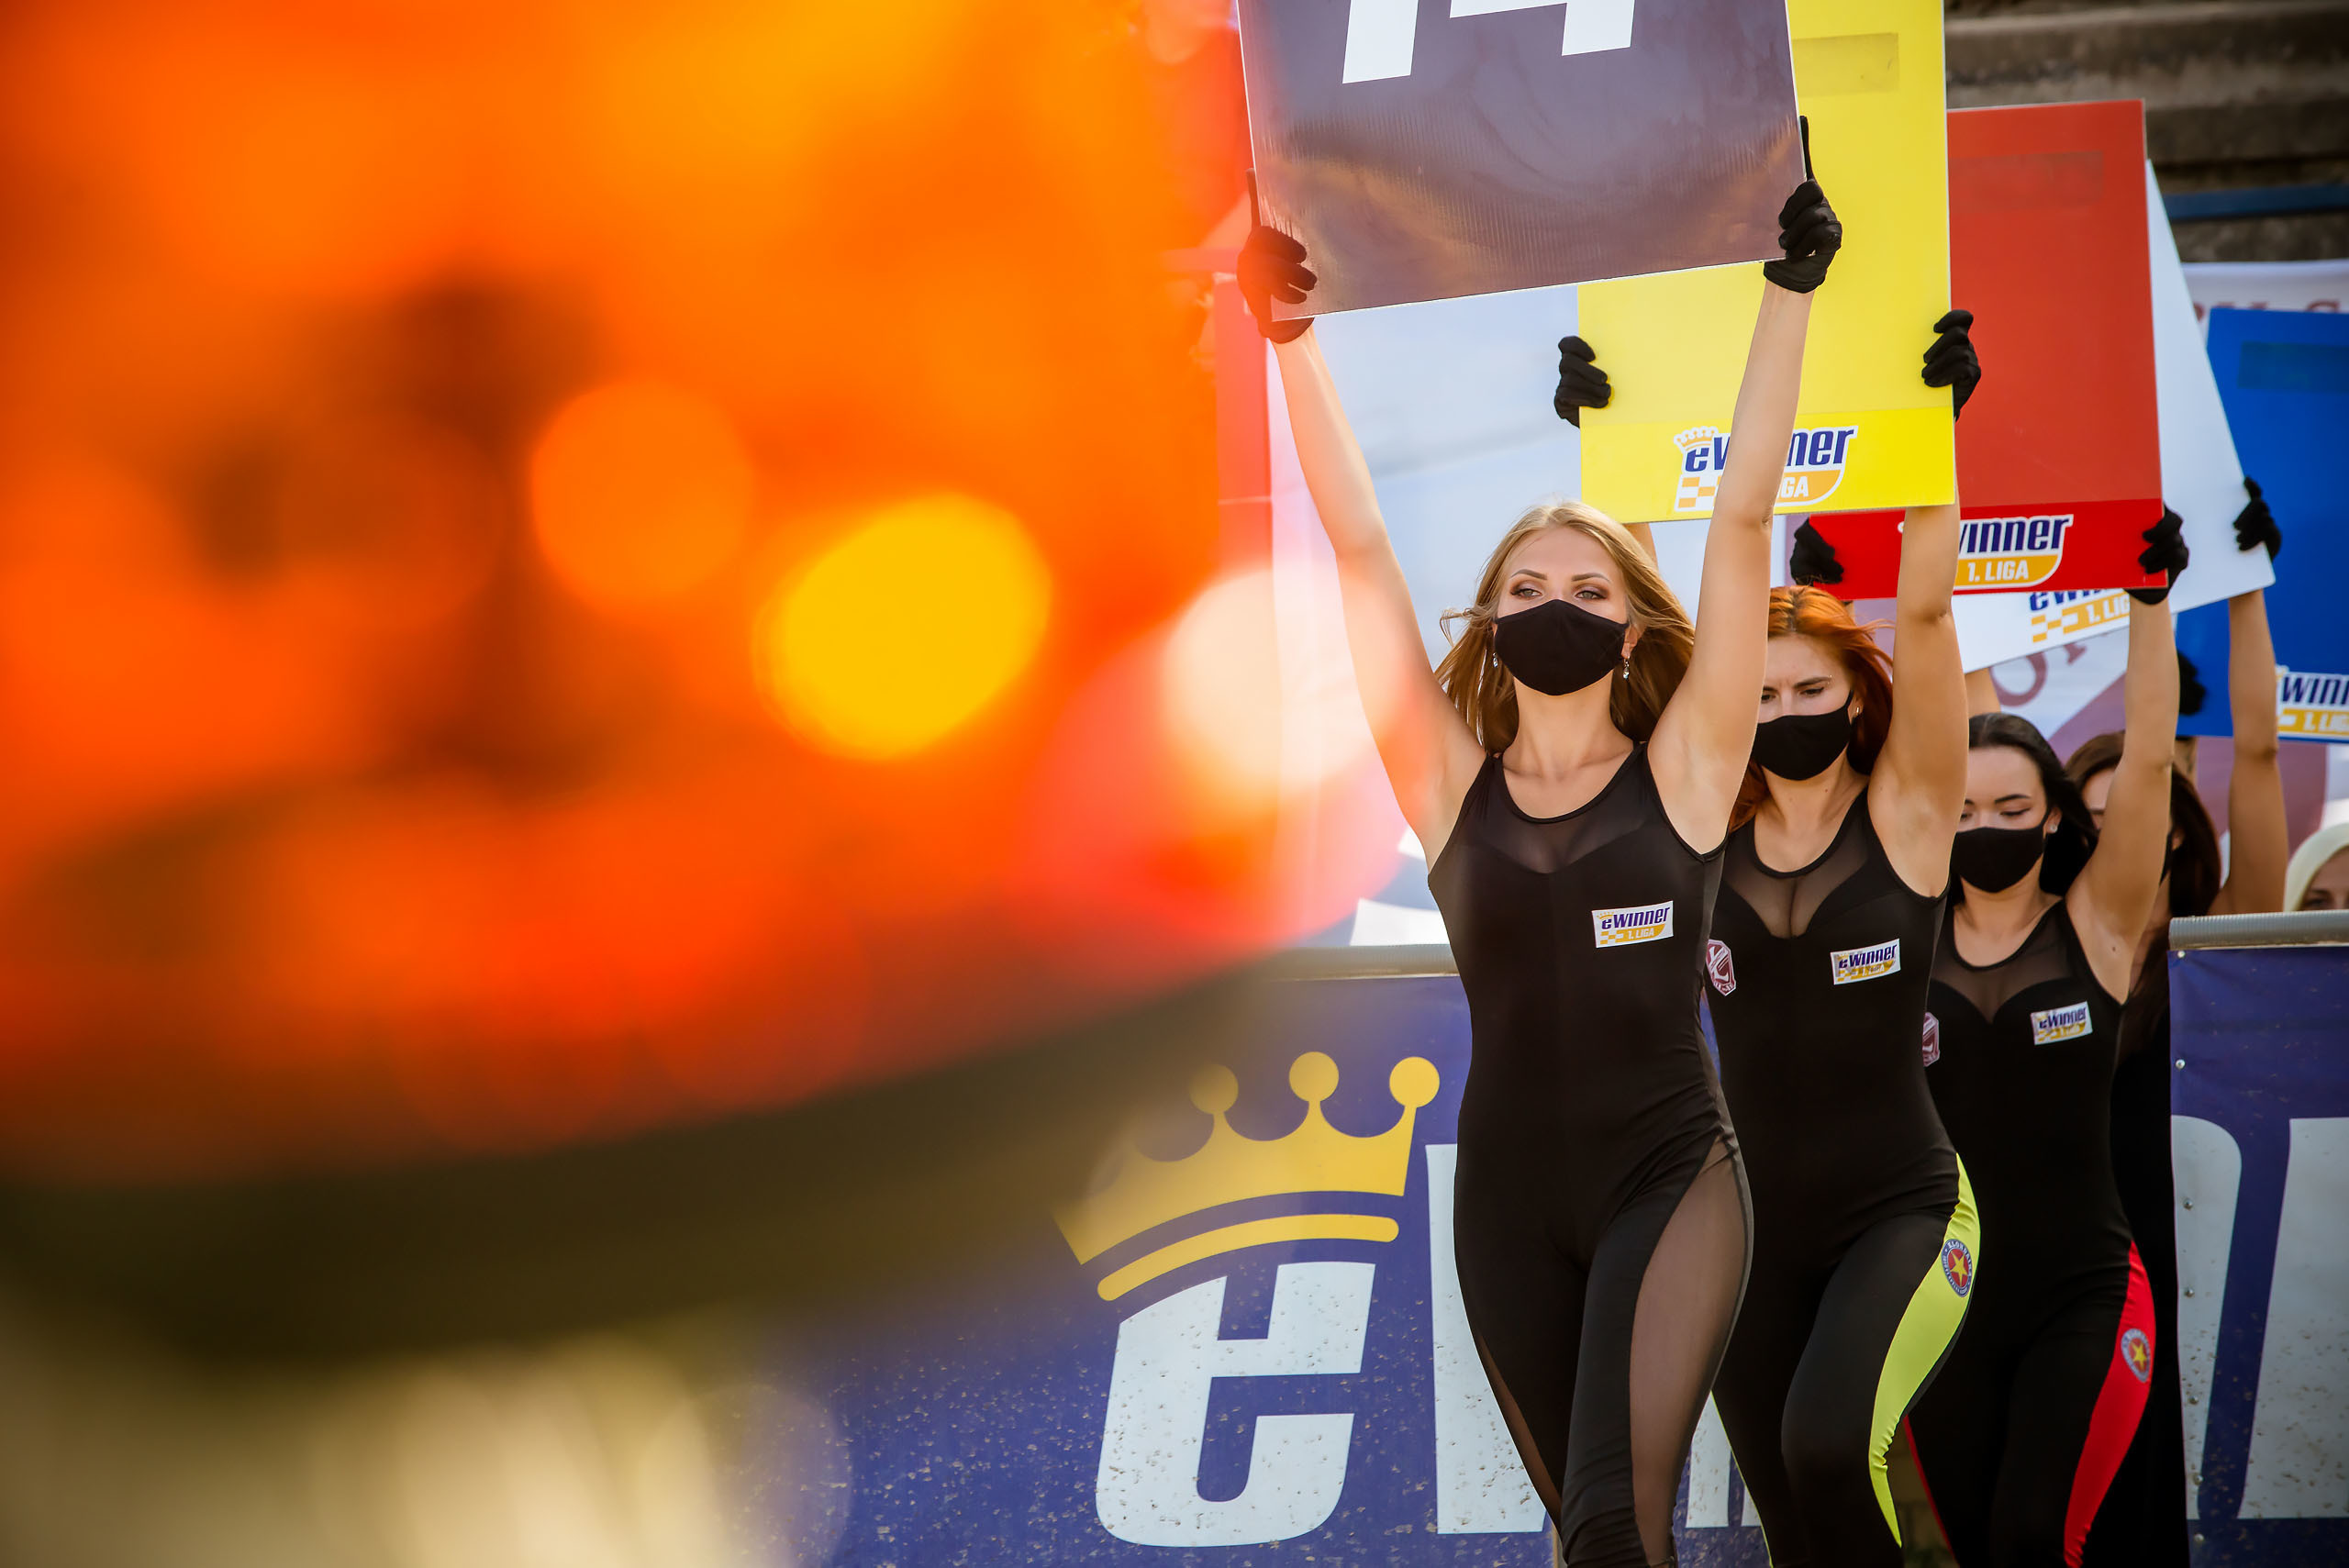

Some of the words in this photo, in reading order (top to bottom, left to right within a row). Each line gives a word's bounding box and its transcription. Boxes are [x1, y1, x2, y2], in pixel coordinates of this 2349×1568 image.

[1777, 475, 1809, 499] GA
[1967, 562, 1981, 582] 1.
[1985, 560, 2030, 581] LIGA
[2103, 594, 2130, 620] LIG
[1635, 928, 1654, 939] LIGA
